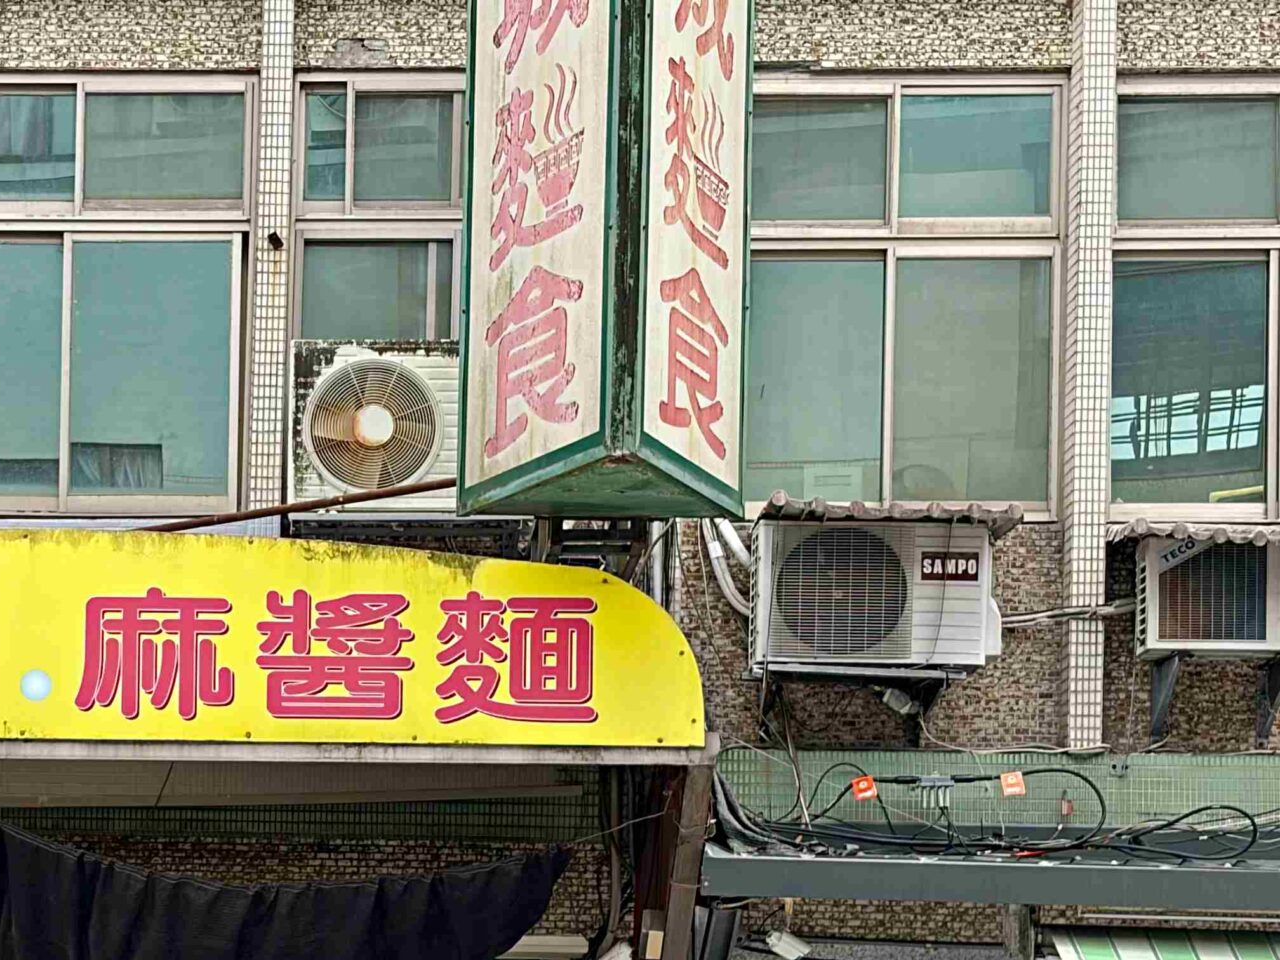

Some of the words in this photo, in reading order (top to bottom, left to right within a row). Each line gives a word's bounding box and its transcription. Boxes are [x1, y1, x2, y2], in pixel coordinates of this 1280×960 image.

[1161, 540, 1196, 562] TECO
[923, 558, 977, 575] SAMPO
[74, 587, 599, 724] 麻醬麵
